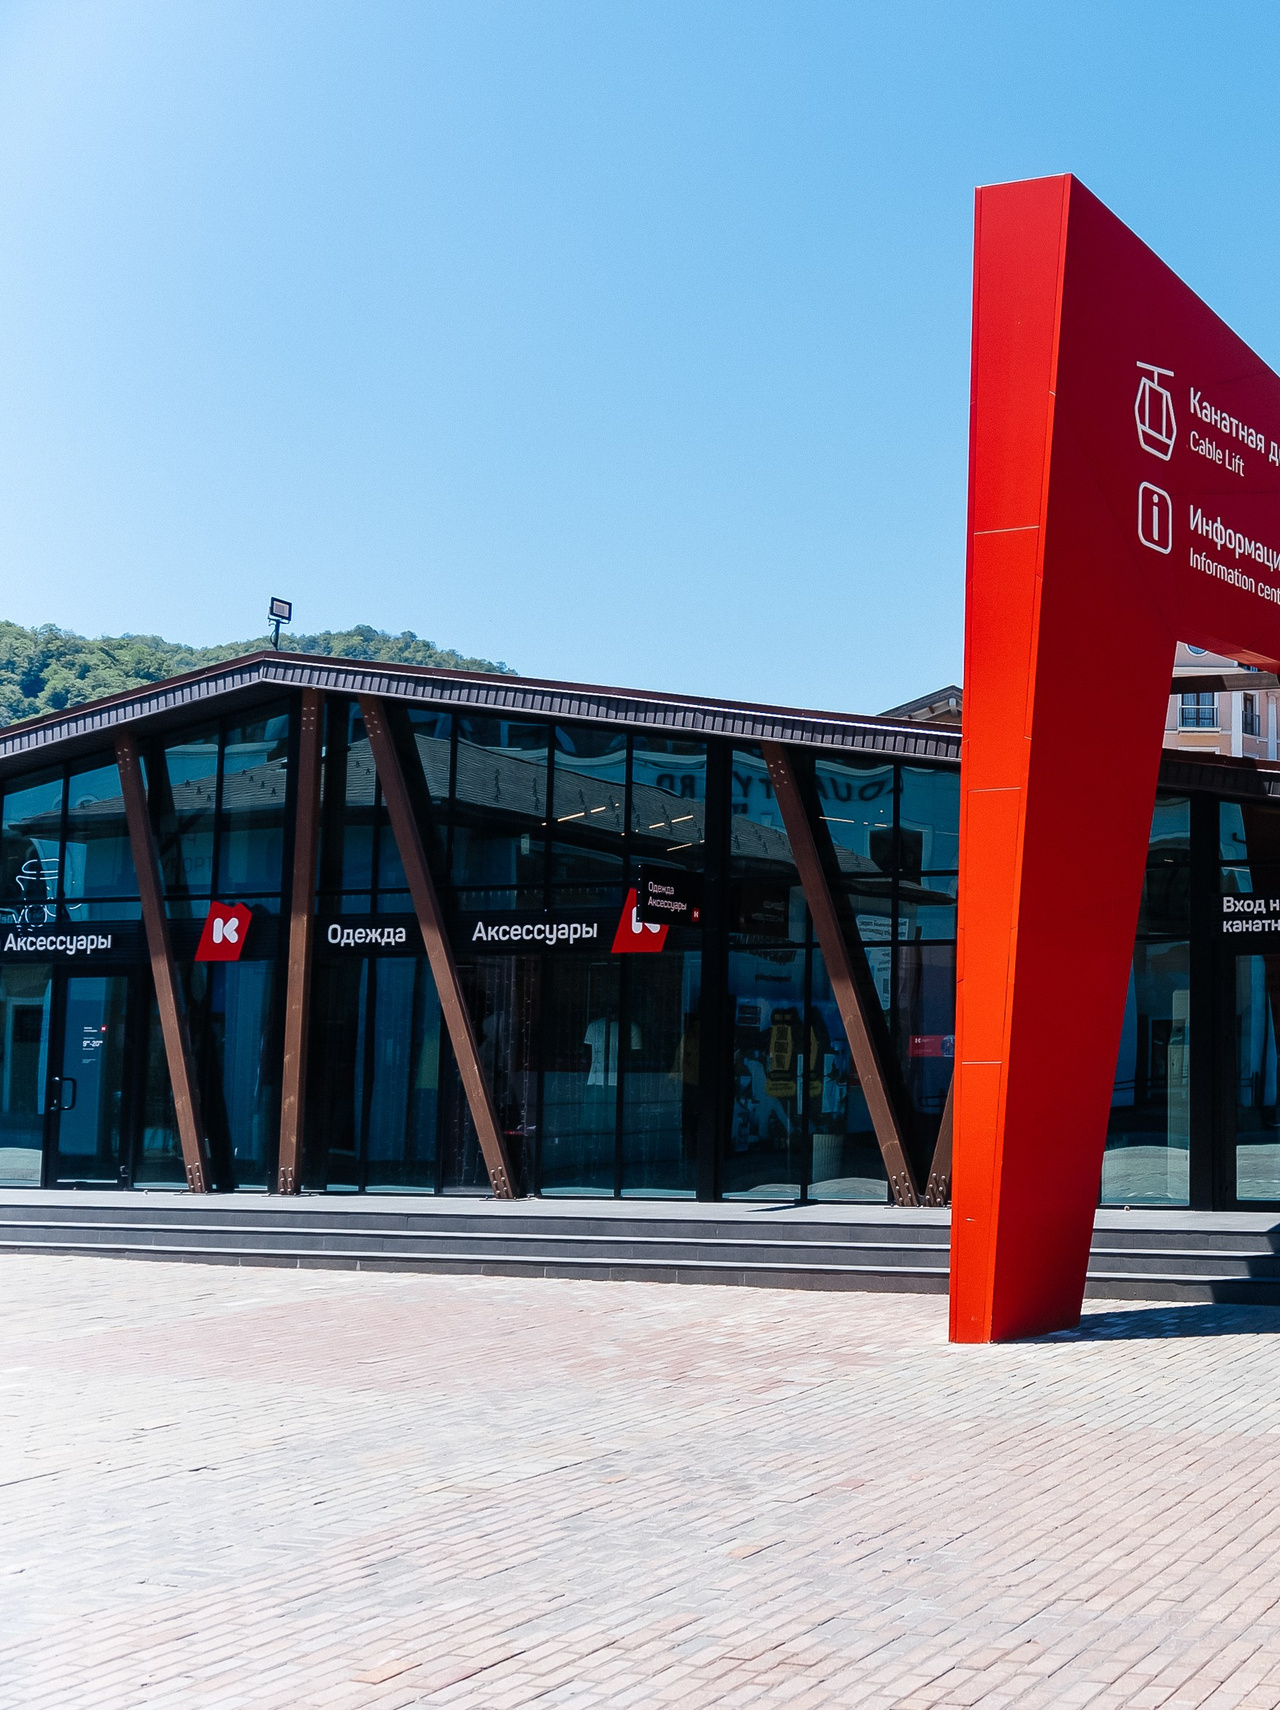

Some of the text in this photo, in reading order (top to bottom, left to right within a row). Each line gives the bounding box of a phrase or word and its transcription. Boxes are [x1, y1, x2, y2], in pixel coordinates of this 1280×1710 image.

[1189, 386, 1265, 454] Канатная
[1189, 430, 1245, 477] Cable Lift
[1189, 547, 1256, 593] Information
[647, 881, 675, 896] Одежда
[647, 896, 688, 912] Аксессуары
[1222, 896, 1267, 915] Вход
[3, 932, 112, 955] Аксессуары
[327, 923, 406, 947] Одежда
[471, 921, 598, 946] Аксессуары
